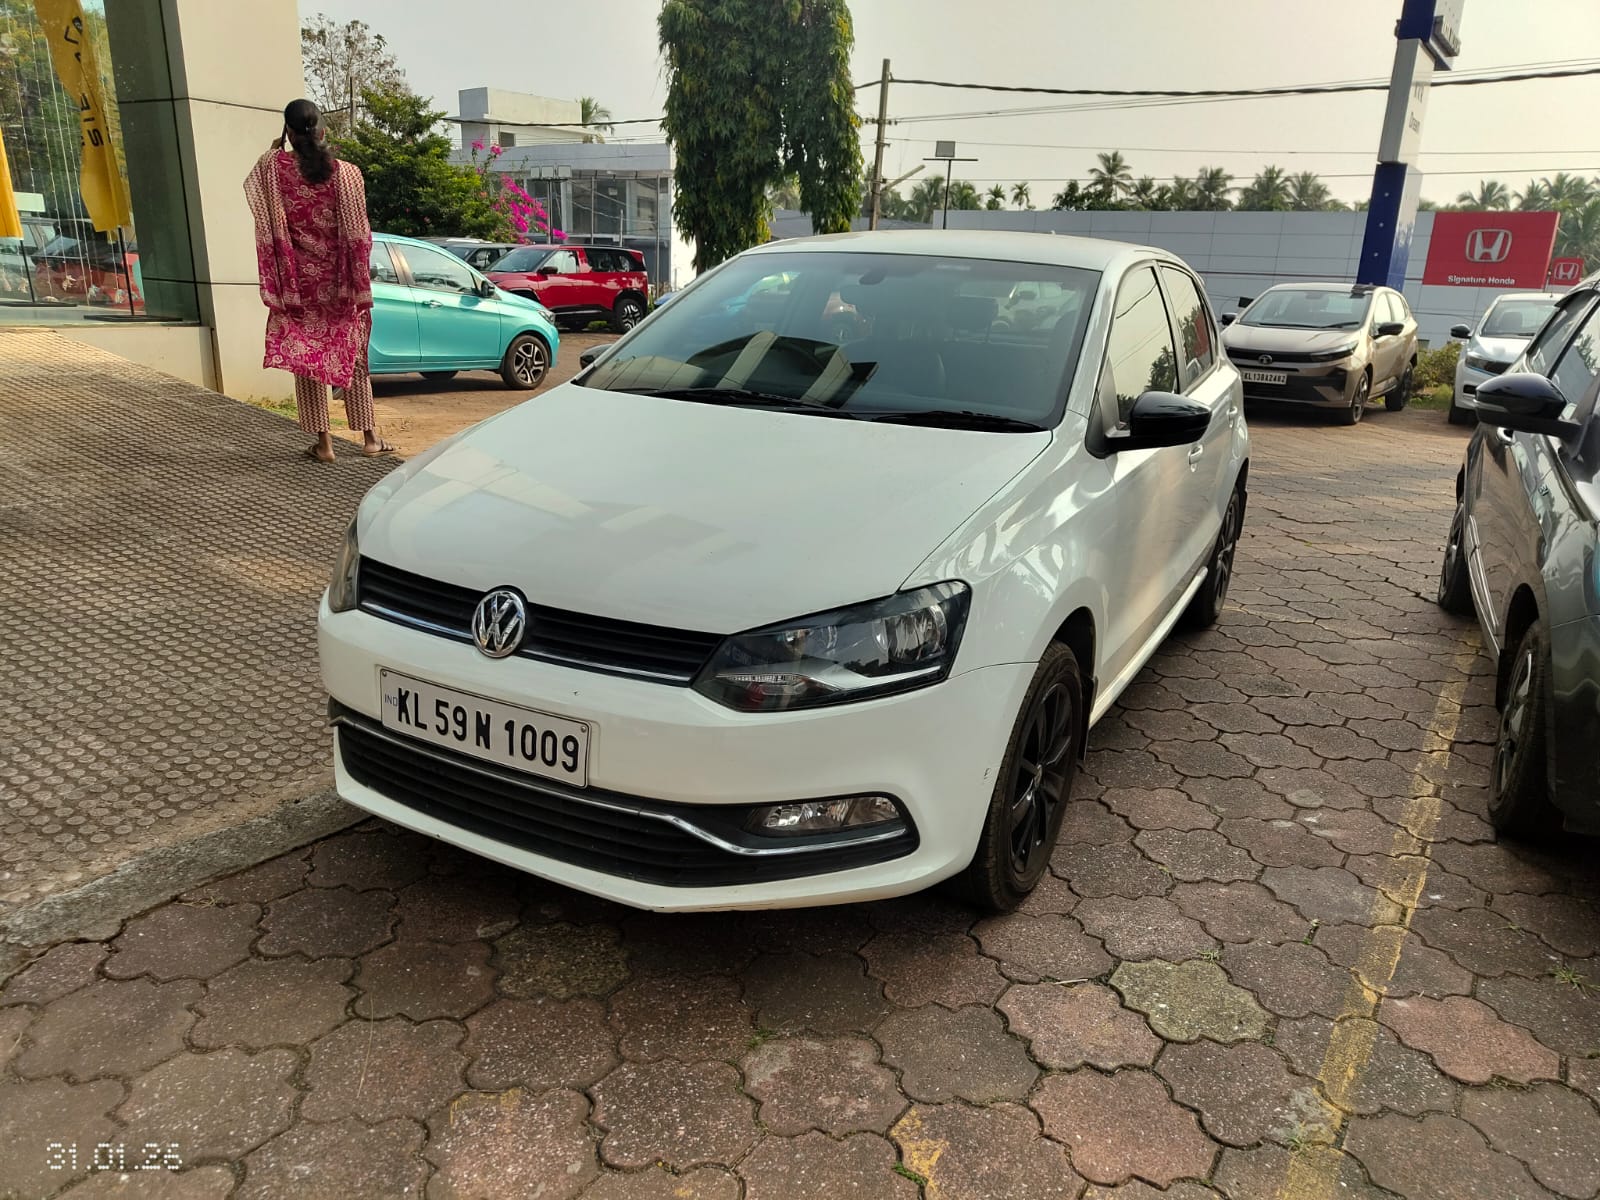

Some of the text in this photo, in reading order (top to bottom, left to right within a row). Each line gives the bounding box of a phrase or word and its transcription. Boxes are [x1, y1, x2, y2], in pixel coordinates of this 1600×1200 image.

[1448, 275, 1515, 285] Signature Honda
[384, 693, 398, 707] IND
[398, 687, 579, 773] KL 59 N 1009
